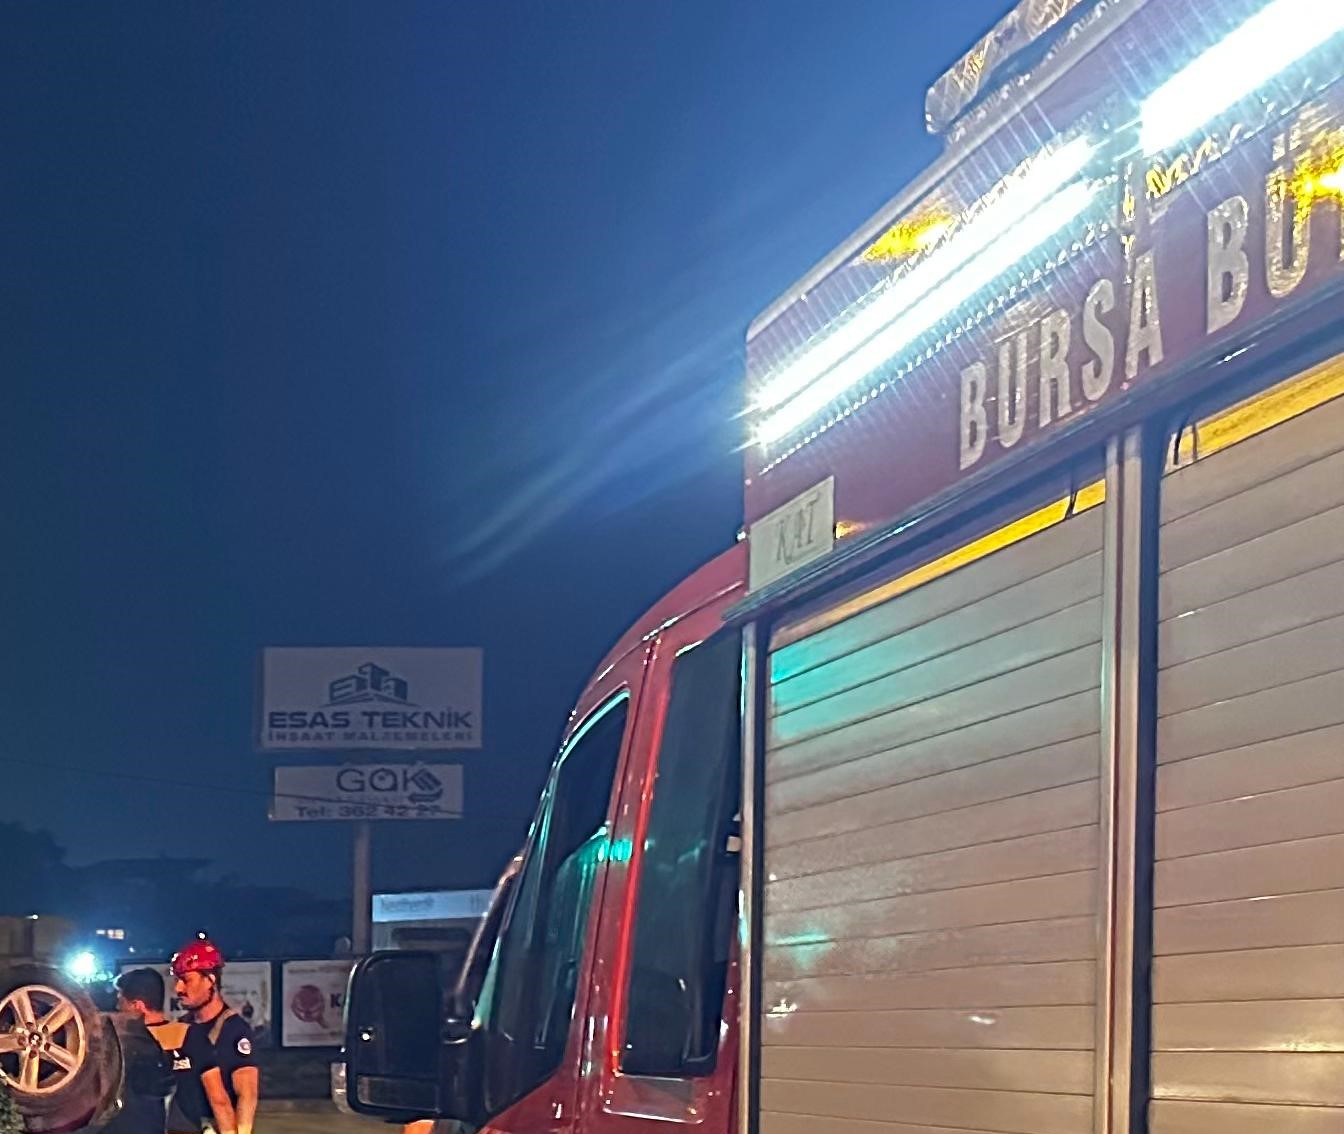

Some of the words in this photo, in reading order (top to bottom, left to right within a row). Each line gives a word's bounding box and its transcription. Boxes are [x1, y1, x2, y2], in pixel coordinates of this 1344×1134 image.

[960, 250, 1165, 471] BURSA
[268, 711, 350, 729] ESAS
[360, 706, 473, 729] TEKNİK
